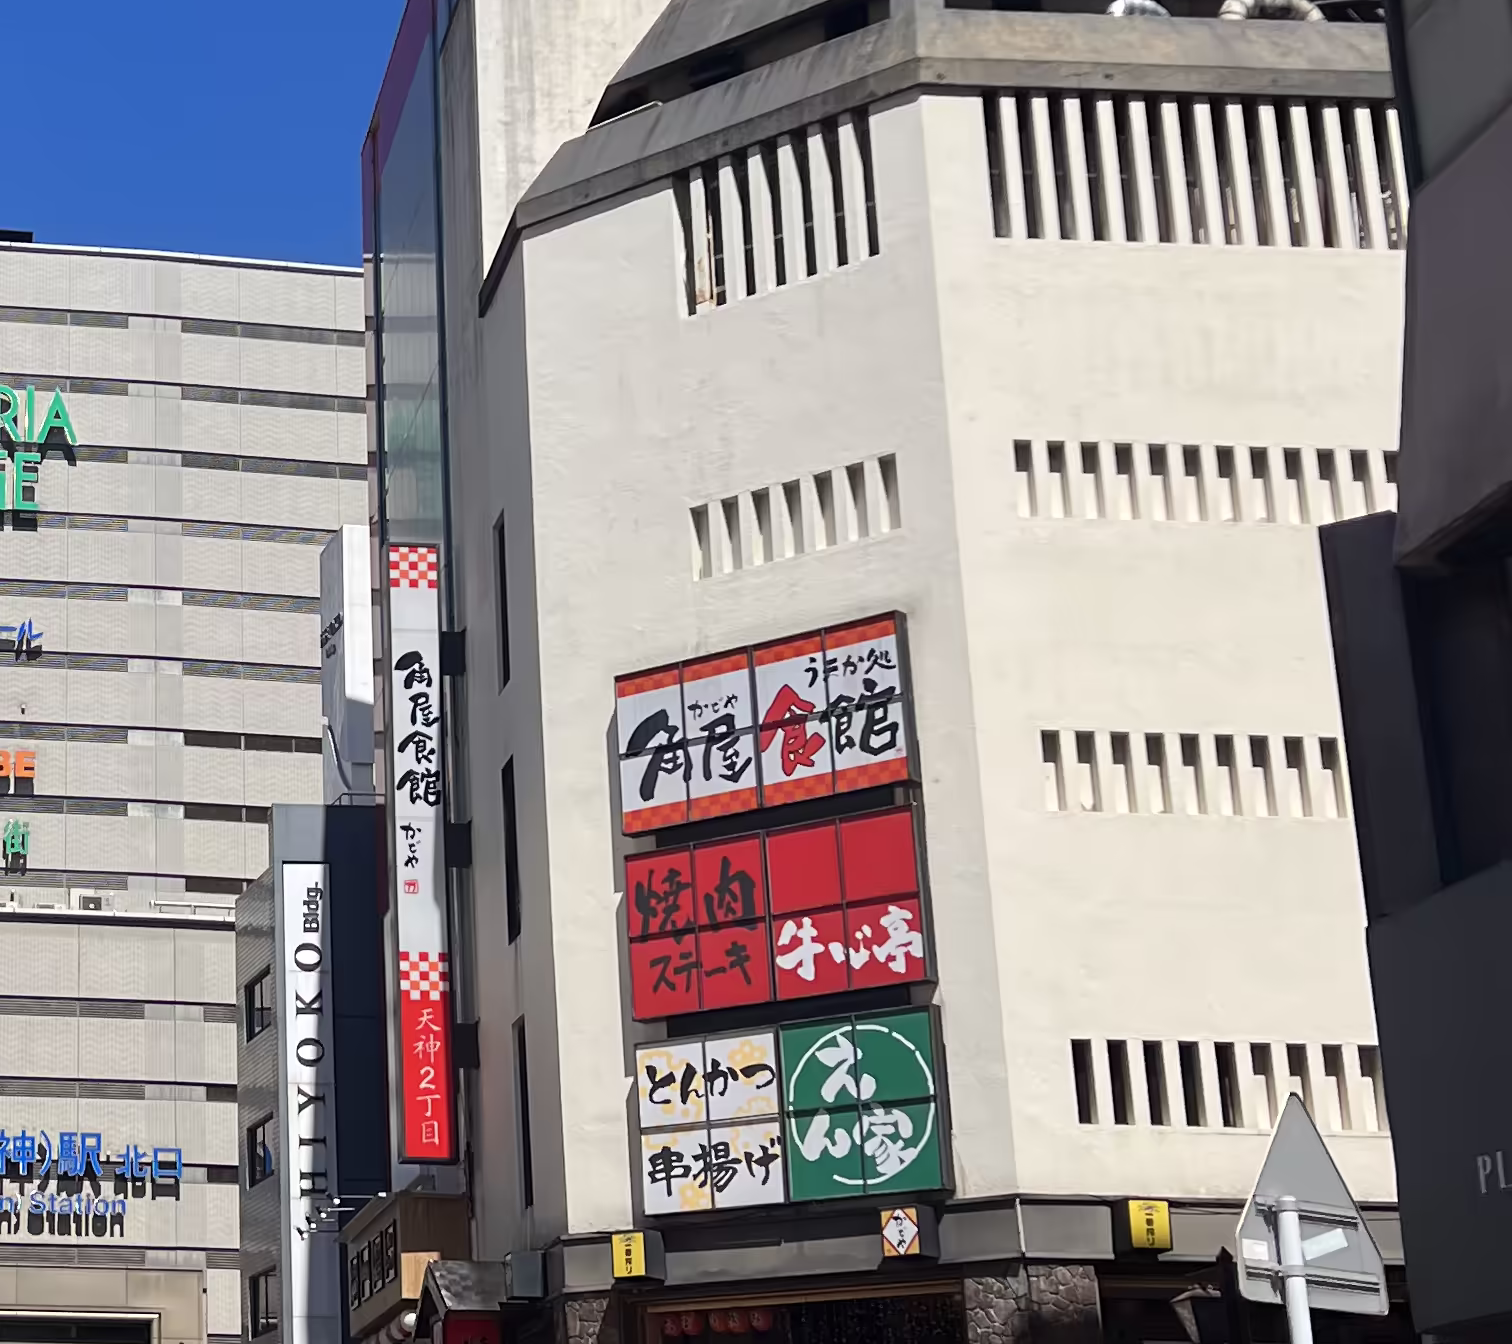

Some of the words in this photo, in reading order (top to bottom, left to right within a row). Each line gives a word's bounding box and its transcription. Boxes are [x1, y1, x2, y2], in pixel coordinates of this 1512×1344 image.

[805, 646, 898, 690] うまか処
[393, 650, 442, 808] 角屋食館
[302, 881, 324, 933] Bldg.
[634, 857, 758, 945] 焼肉
[649, 940, 754, 994] ステーキ
[293, 941, 328, 1201] HIYOKO
[412, 1007, 442, 1147] 天神2丁目
[645, 1058, 777, 1107] とんかつ
[115, 1144, 183, 1180] 北口
[647, 1134, 784, 1198] 串揚げ
[28, 1189, 128, 1217] Station
